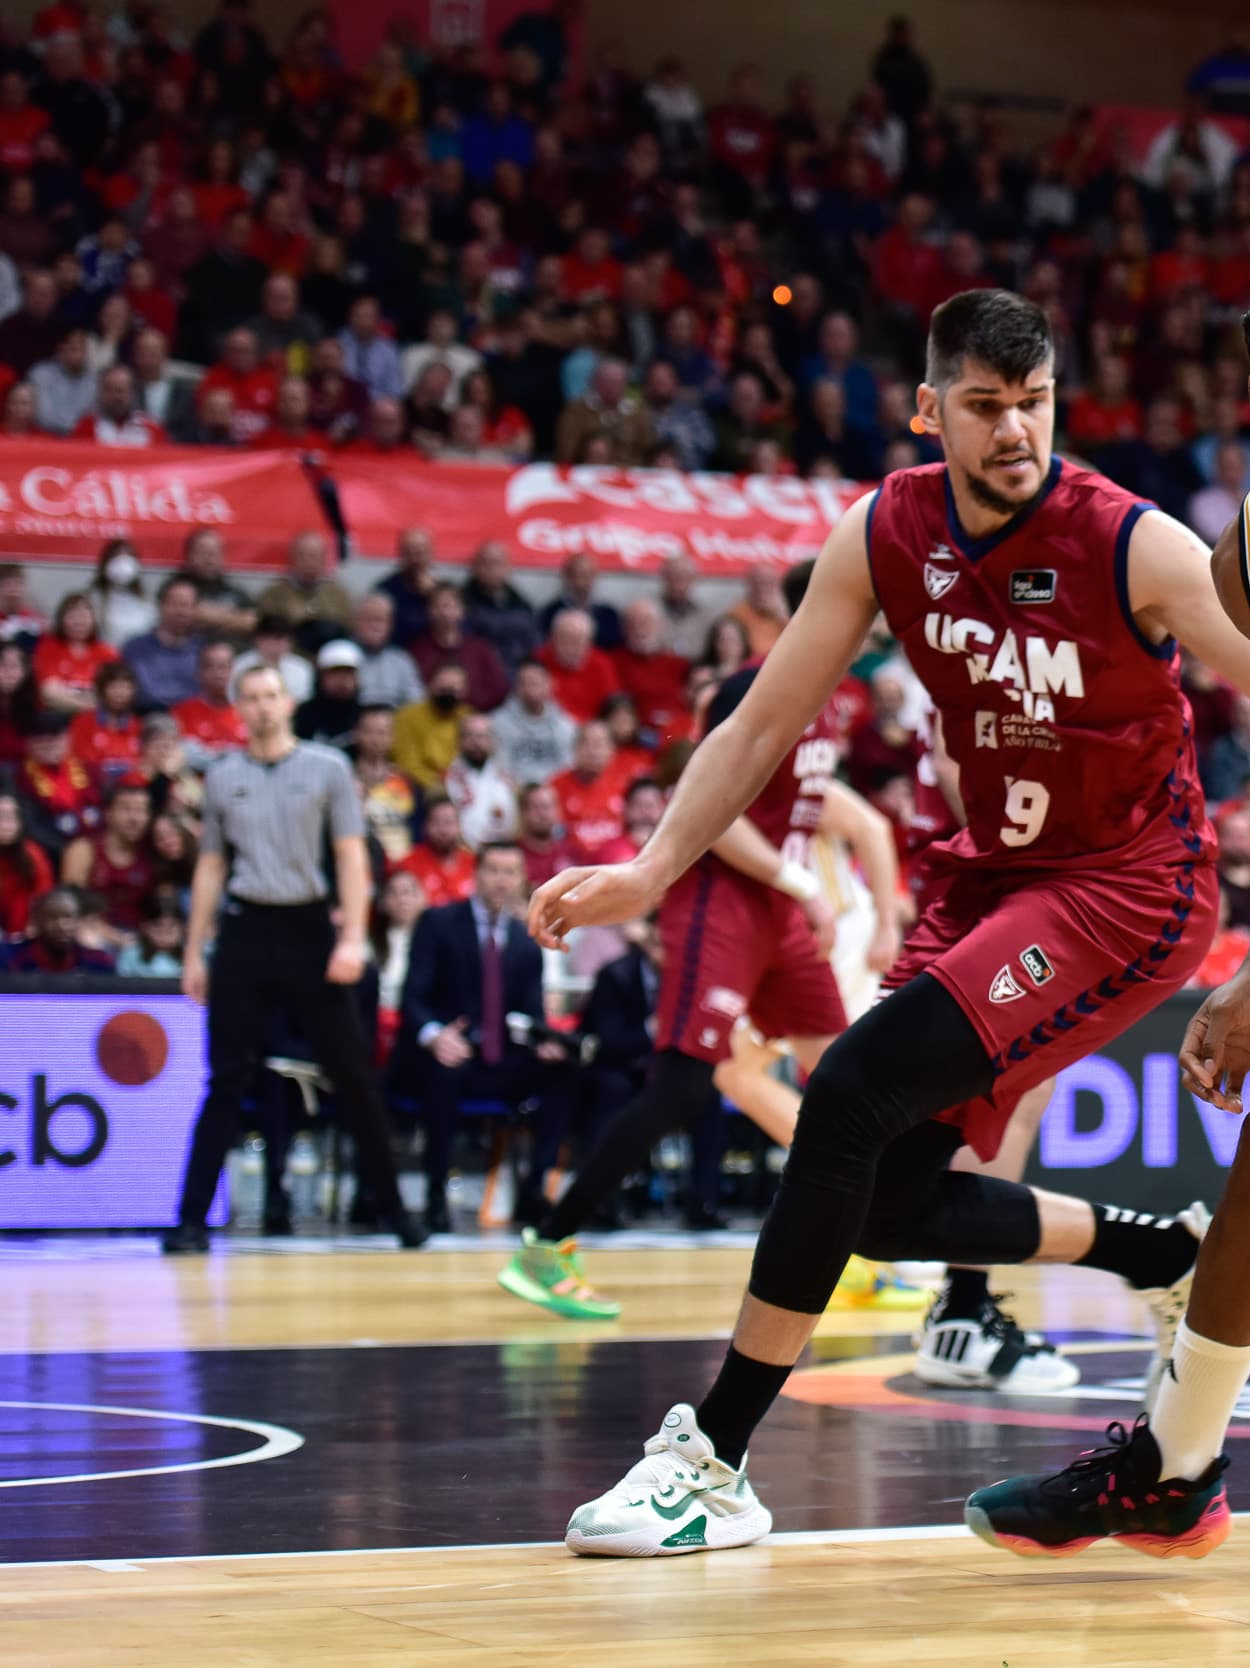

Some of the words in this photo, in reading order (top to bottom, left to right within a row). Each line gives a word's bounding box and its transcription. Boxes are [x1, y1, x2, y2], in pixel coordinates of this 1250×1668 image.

[19, 465, 235, 525] Cálida
[924, 612, 1085, 698] UCAM
[1024, 953, 1043, 977] acb
